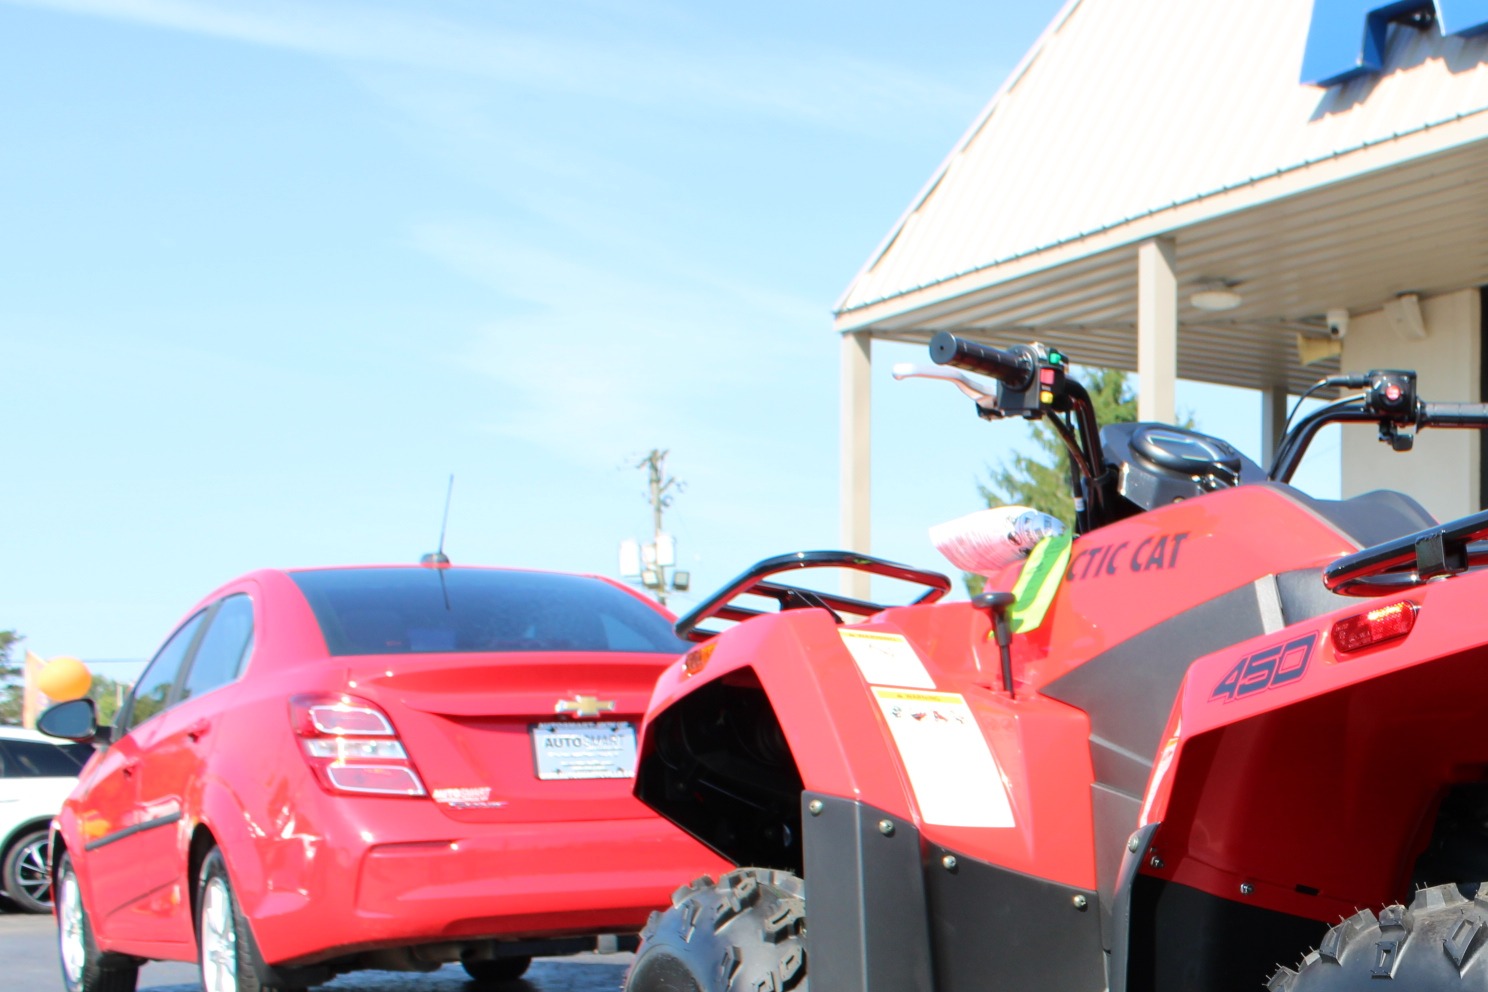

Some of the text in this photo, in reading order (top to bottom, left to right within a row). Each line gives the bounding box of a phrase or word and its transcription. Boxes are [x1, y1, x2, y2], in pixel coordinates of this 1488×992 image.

[1065, 541, 1130, 582] CTIC
[1130, 531, 1190, 573] CAT
[1209, 631, 1319, 703] 450
